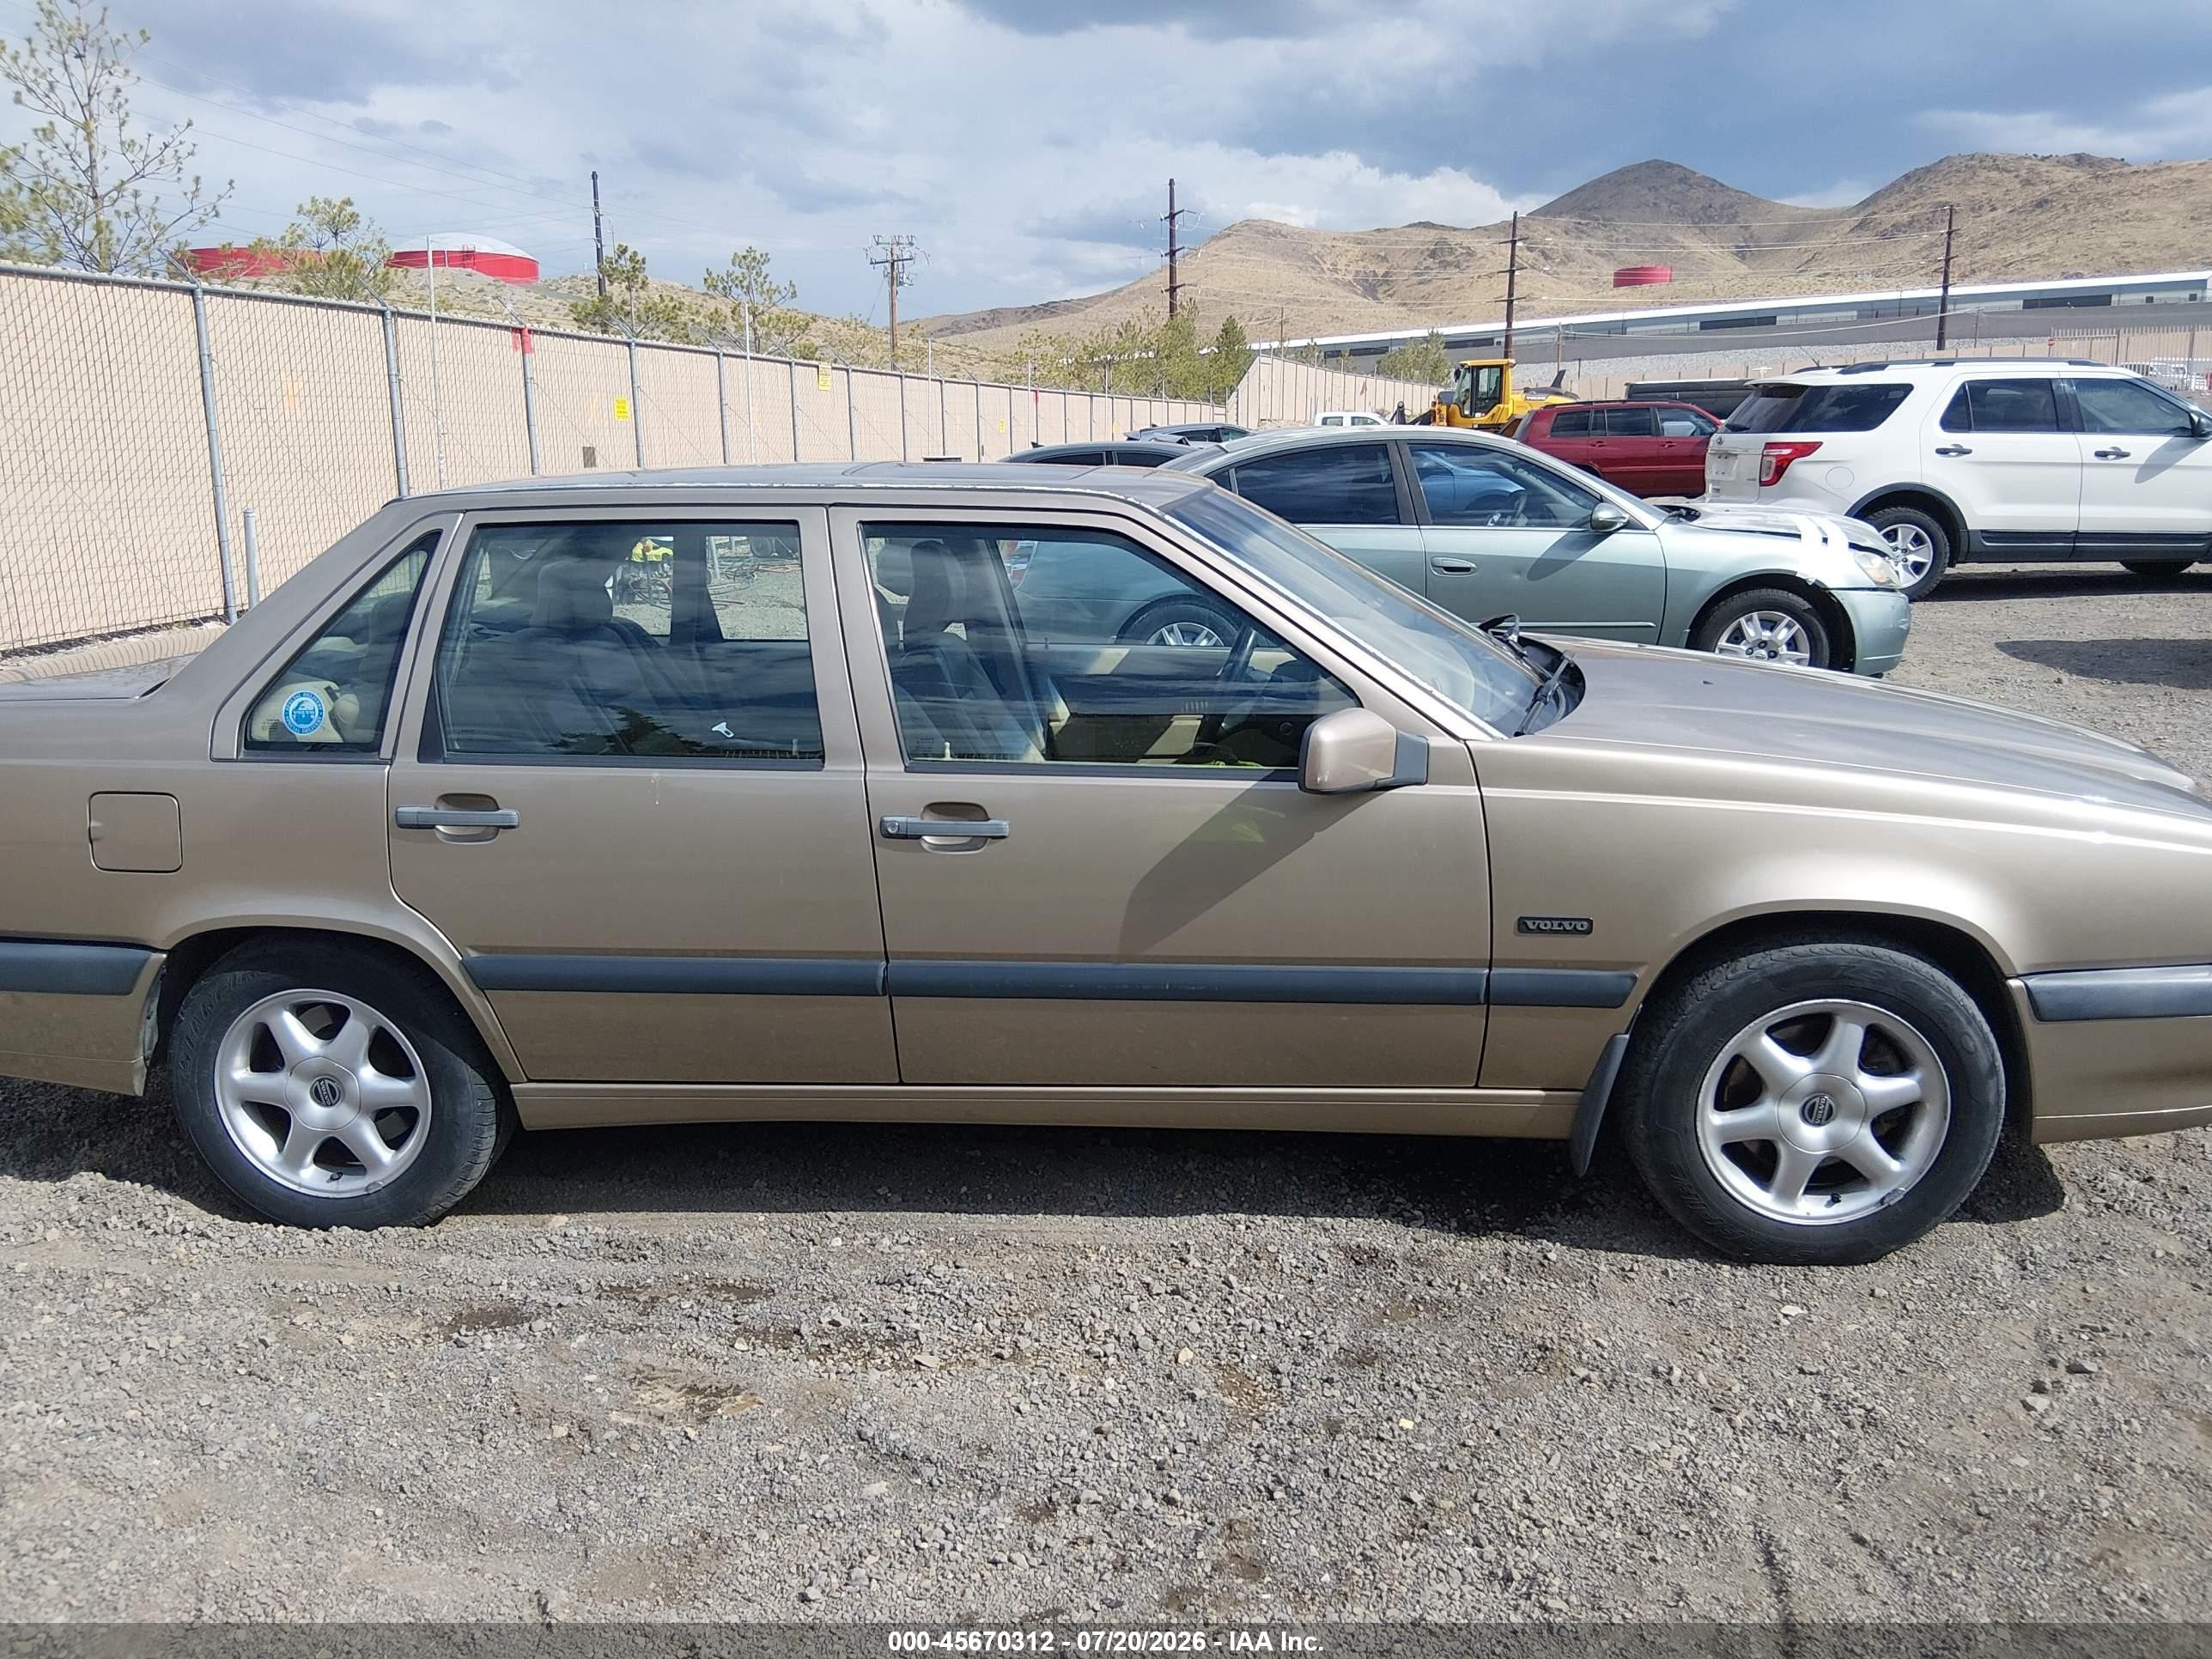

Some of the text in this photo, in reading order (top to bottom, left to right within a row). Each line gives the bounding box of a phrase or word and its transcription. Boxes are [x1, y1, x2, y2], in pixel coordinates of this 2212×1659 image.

[1524, 920, 1589, 931] VOLVO
[319, 1080, 331, 1105] VOLVO
[1814, 1097, 1826, 1124] VOLVO
